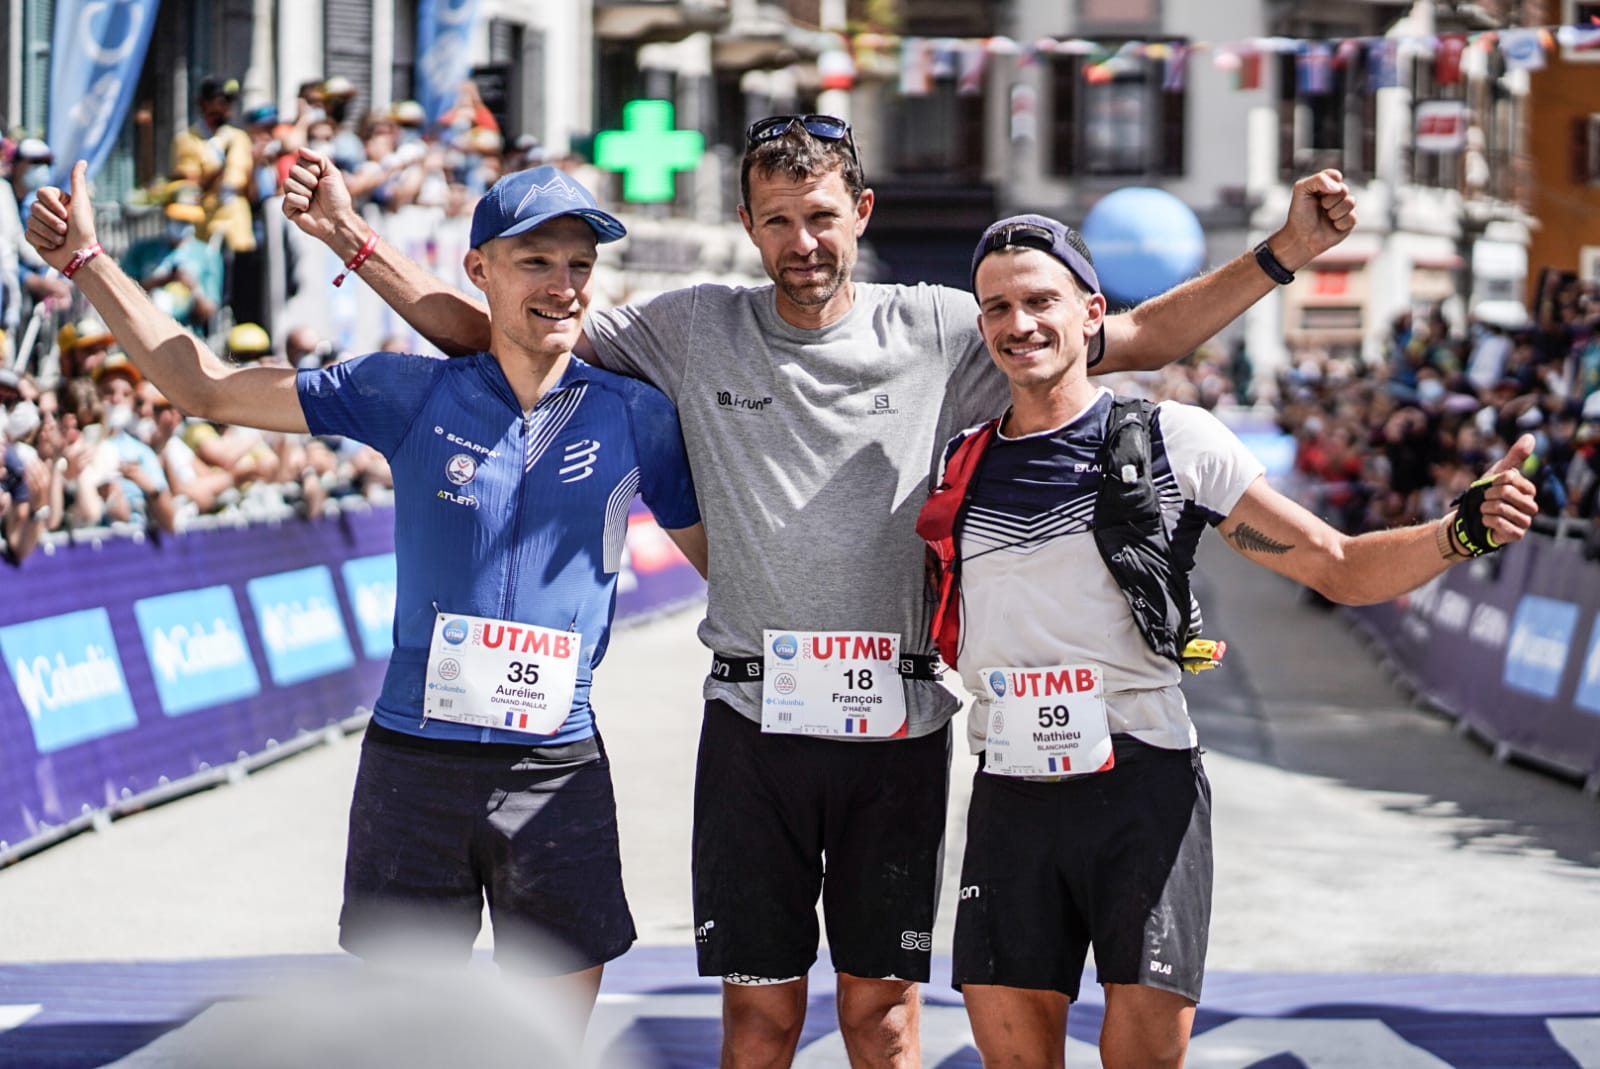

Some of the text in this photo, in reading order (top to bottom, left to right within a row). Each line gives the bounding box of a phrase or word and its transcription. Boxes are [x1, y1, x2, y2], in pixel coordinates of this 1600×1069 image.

[446, 433, 497, 459] SCARPA
[482, 623, 571, 659] UTMB
[802, 637, 812, 660] 2021
[812, 636, 892, 661] UTMB
[507, 661, 539, 685] 35
[843, 668, 874, 690] 18
[1012, 668, 1095, 698] UTMB
[490, 696, 548, 710] DUNAND-PALLAZ
[495, 684, 545, 701] Aurélien
[832, 692, 883, 706] François
[1038, 704, 1070, 728] 59
[1032, 730, 1081, 743] Mathieu
[1036, 742, 1079, 752] BLANCHARD
